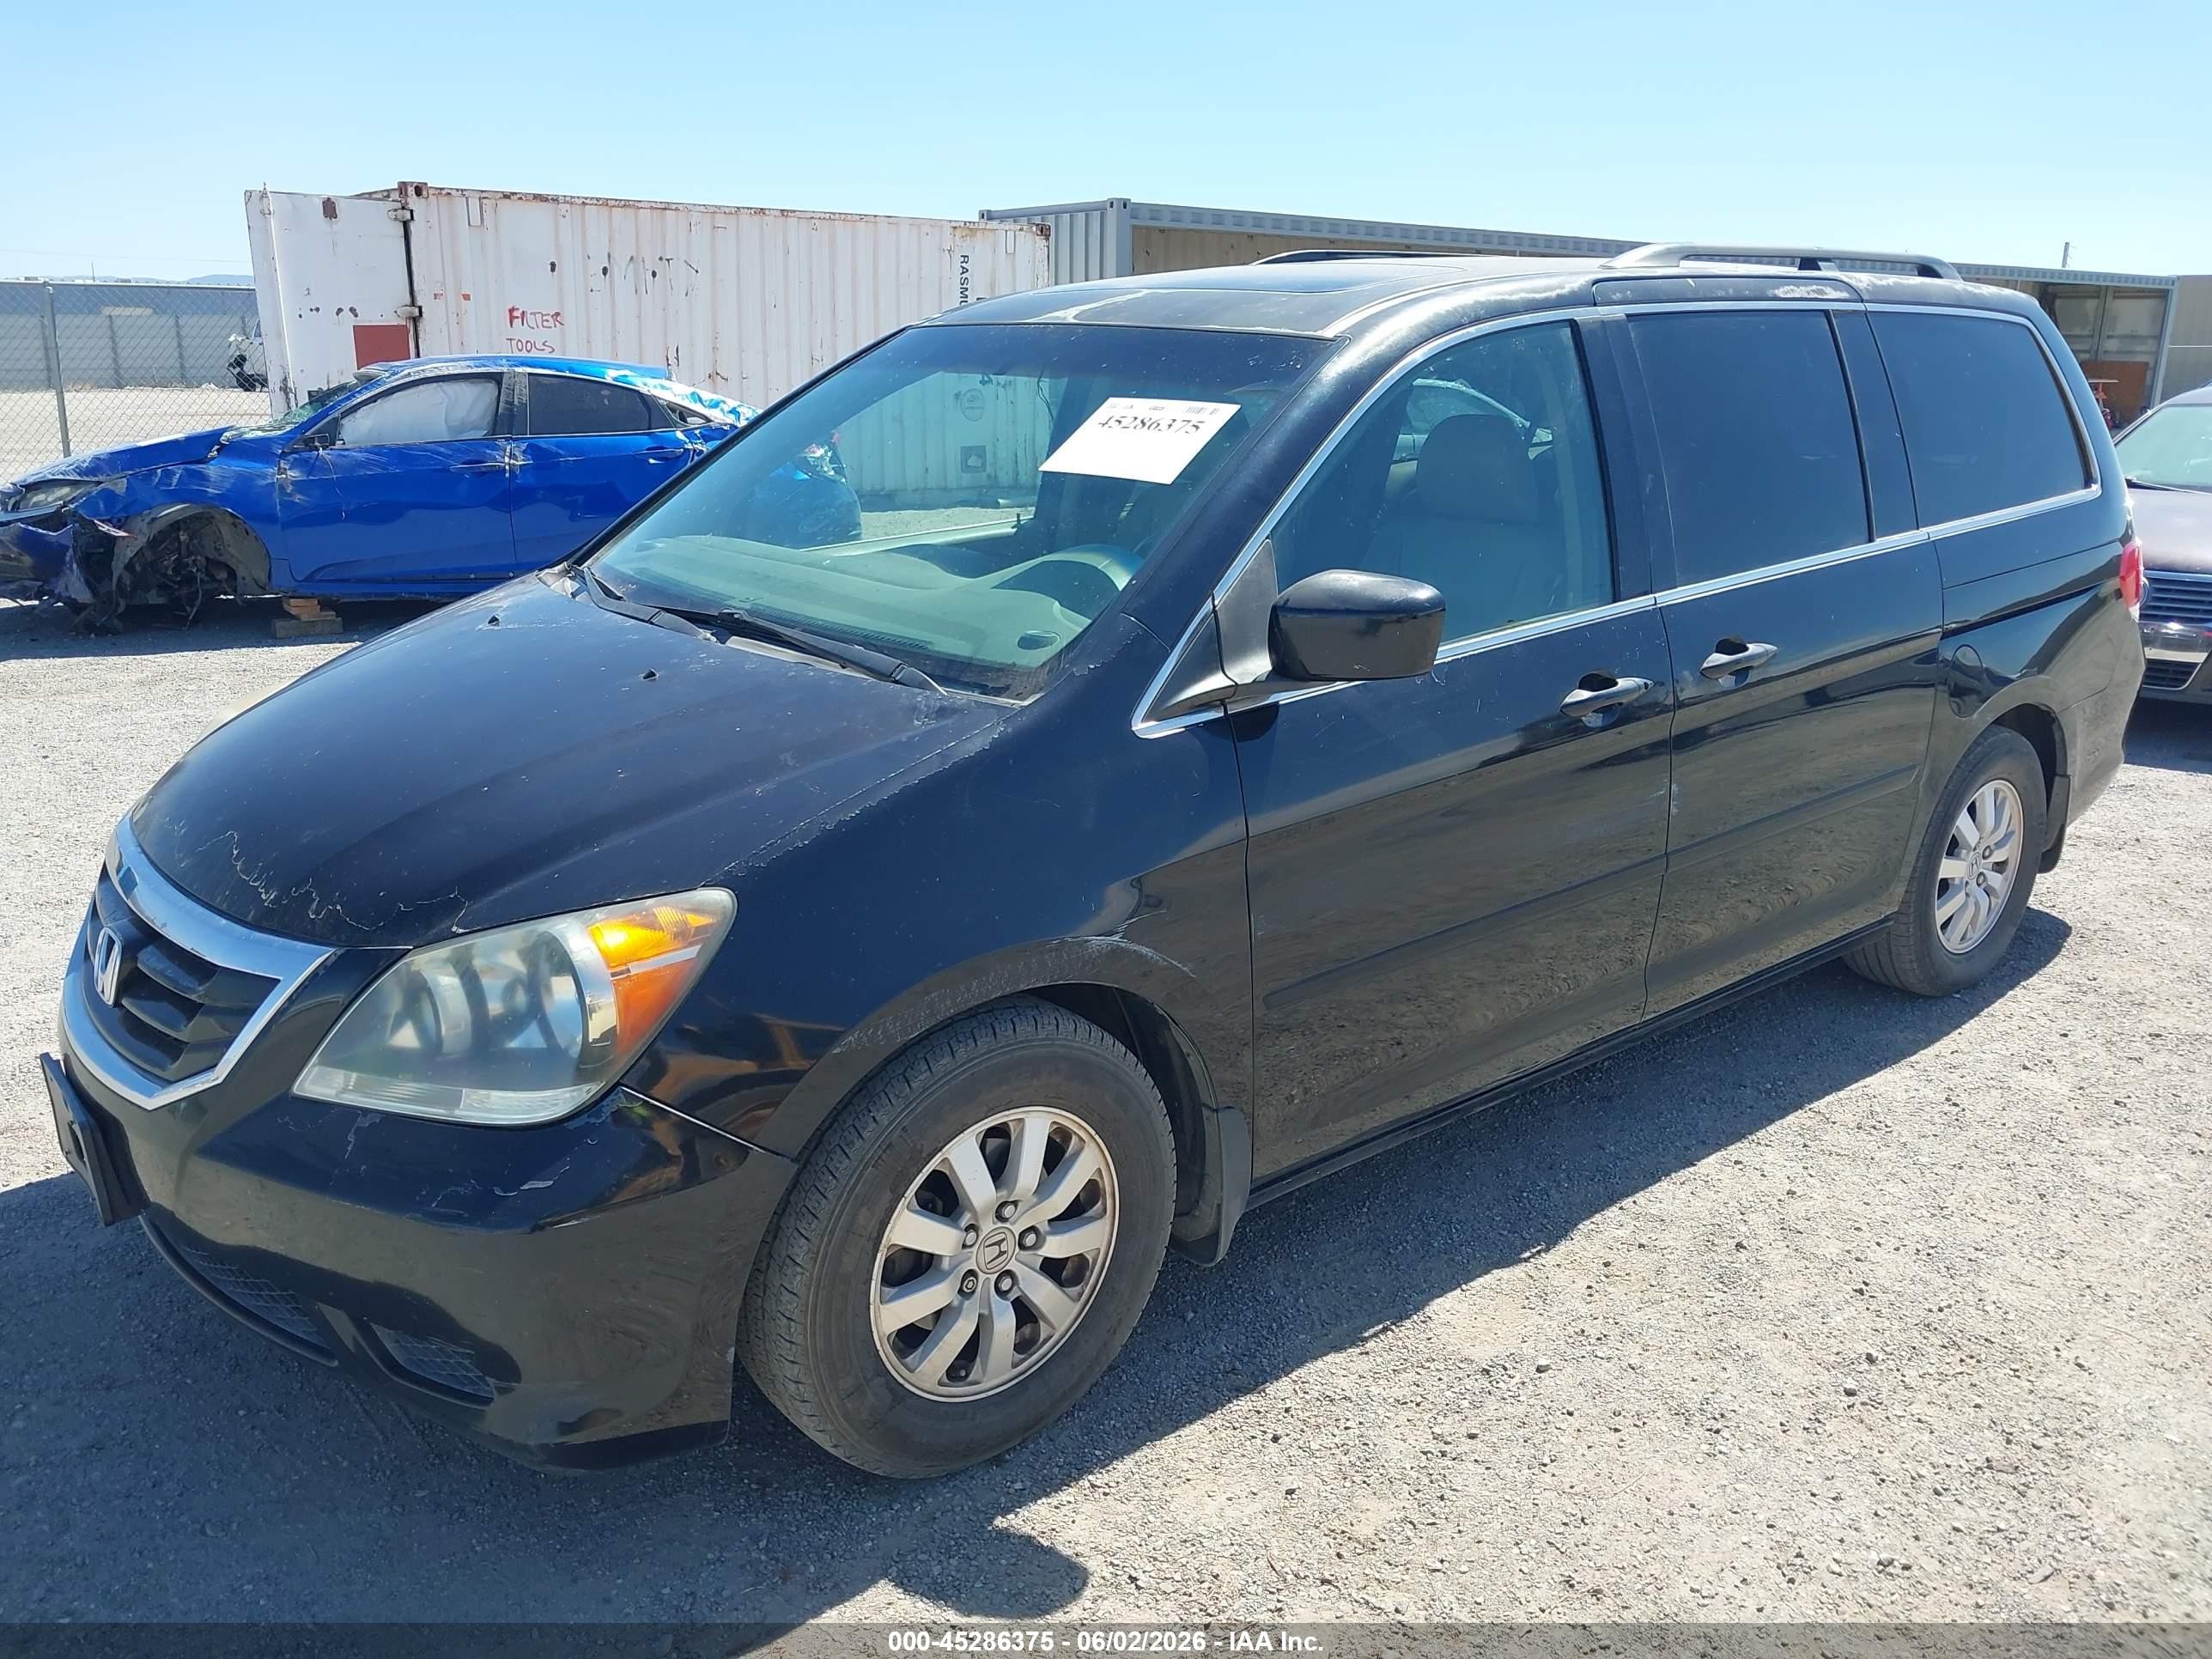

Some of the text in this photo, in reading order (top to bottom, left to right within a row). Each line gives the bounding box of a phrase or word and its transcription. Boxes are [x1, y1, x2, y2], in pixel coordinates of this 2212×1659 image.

[508, 305, 565, 330] FILTER
[506, 337, 556, 354] TOOLS
[1098, 415, 1206, 434] 45286375
